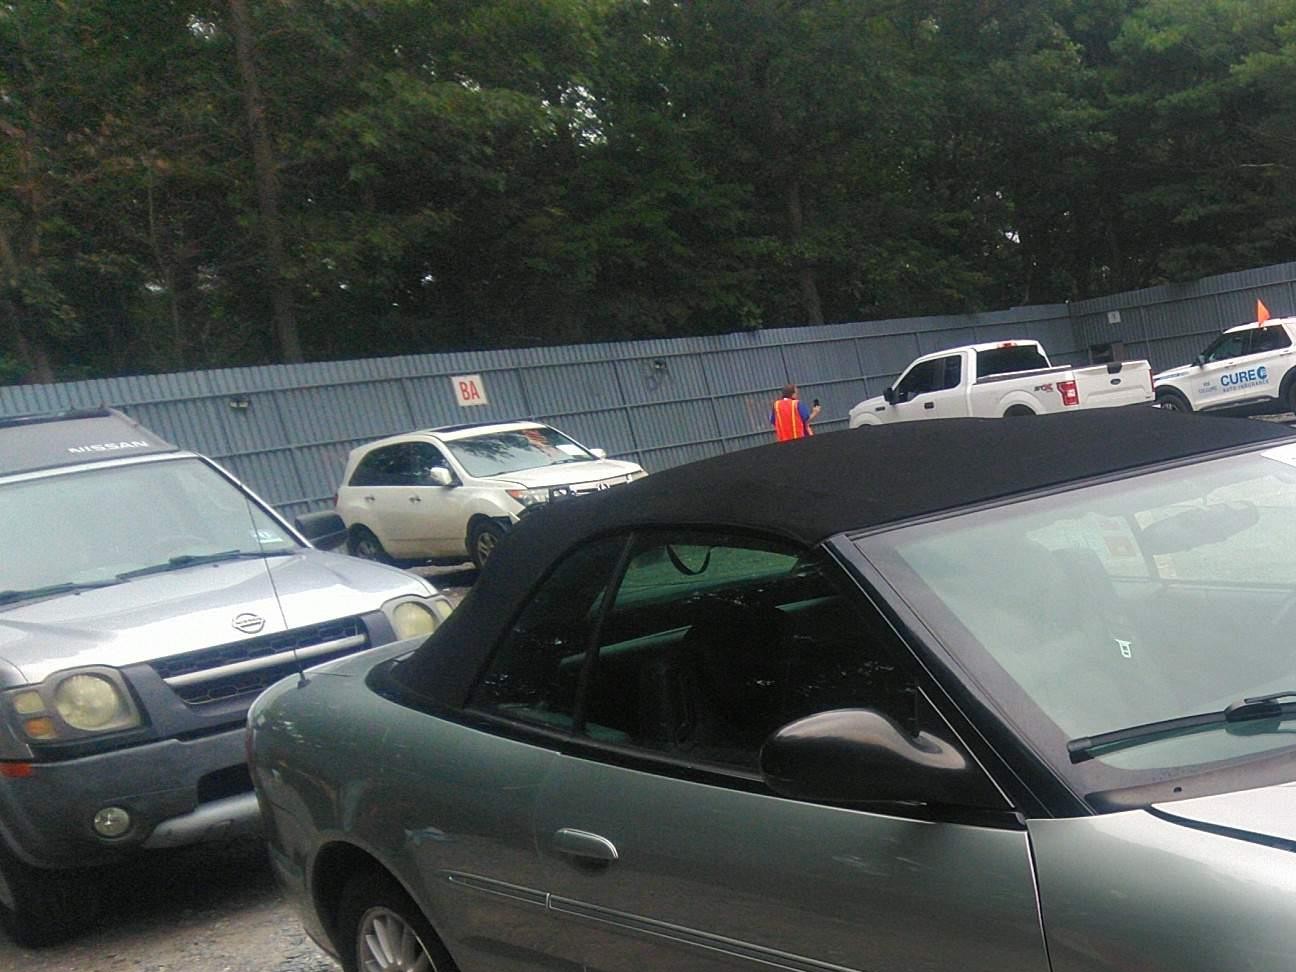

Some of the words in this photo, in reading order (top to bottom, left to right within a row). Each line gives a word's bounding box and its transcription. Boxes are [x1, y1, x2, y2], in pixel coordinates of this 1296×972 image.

[1220, 368, 1257, 387] CURE
[458, 380, 480, 401] BA
[68, 440, 149, 455] NISSAN
